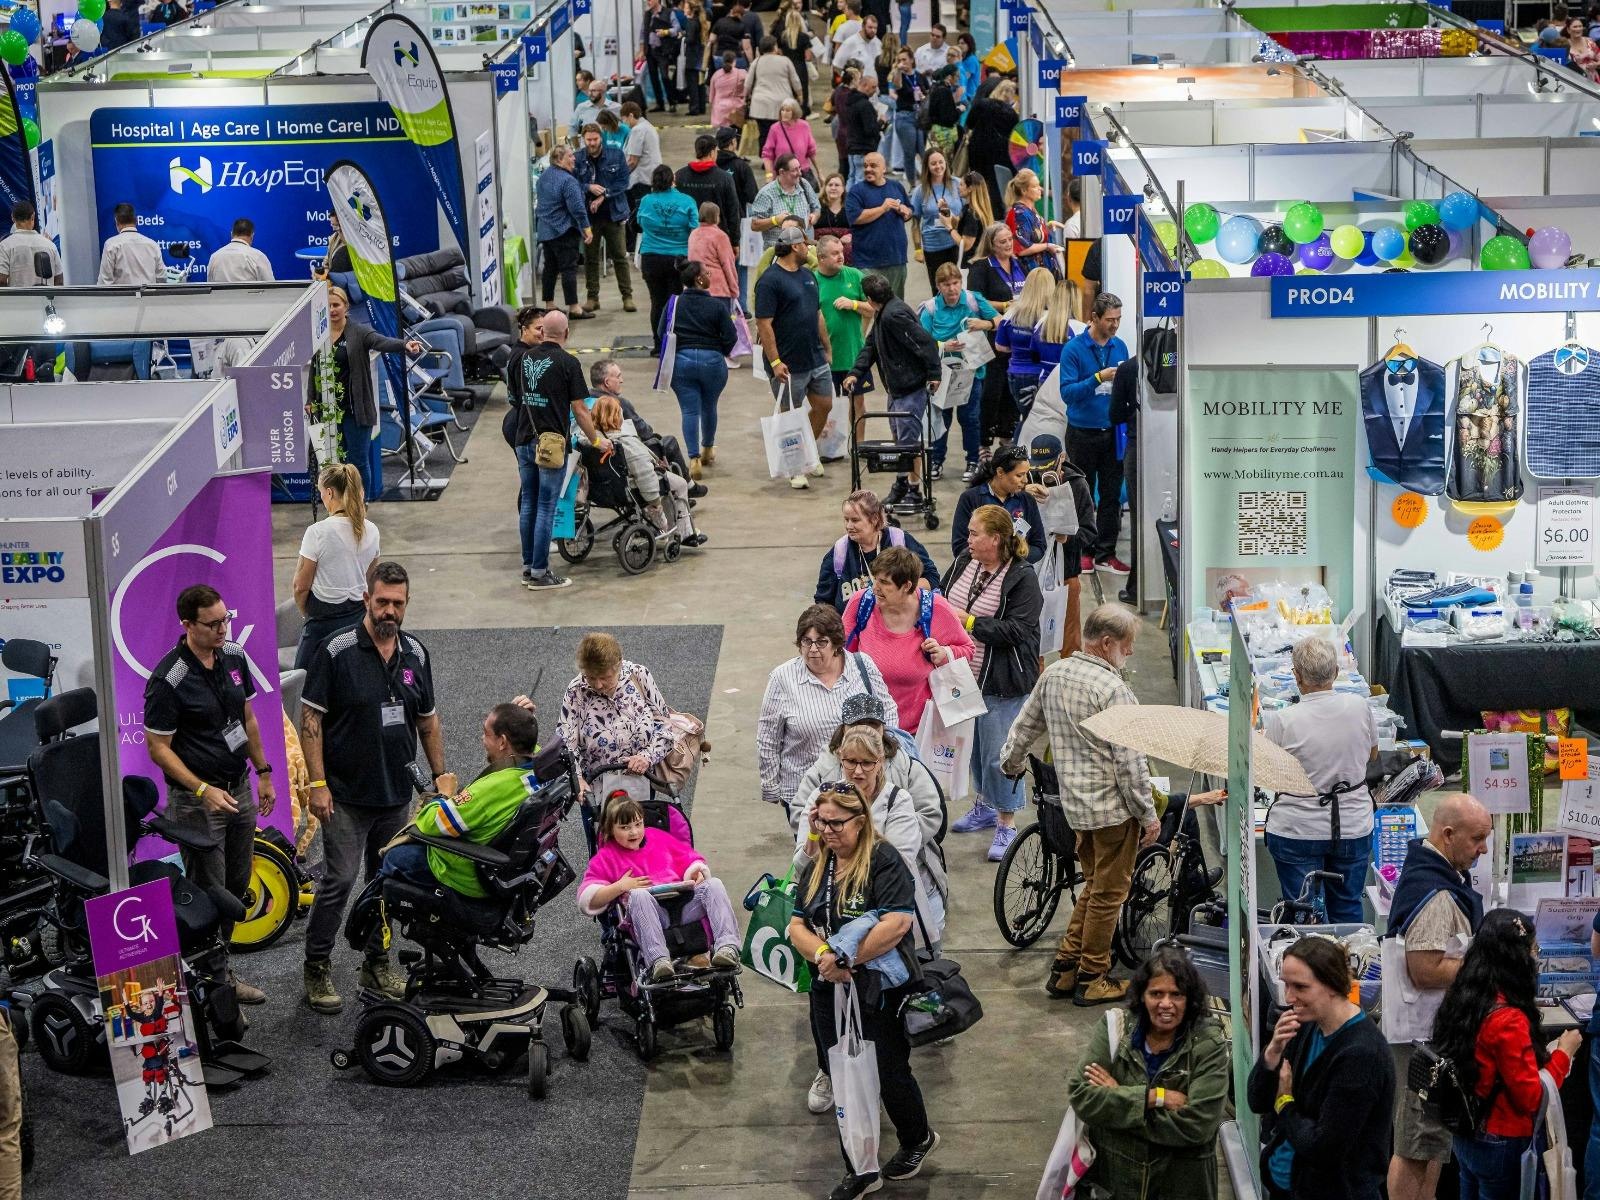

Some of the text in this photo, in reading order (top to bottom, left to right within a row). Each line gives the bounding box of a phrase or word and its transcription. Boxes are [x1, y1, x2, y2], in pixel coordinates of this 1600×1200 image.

[1012, 16, 1028, 24] 102
[530, 45, 540, 54] 91
[496, 69, 517, 77] PROD
[1042, 70, 1060, 80] 104
[16, 83, 35, 92] PROD
[504, 79, 510, 87] 3
[1059, 107, 1080, 118] 105
[111, 121, 174, 140] Hospital
[191, 122, 220, 139] Age
[224, 121, 260, 136] Care
[277, 120, 324, 135] Home
[1077, 152, 1100, 165] 106
[137, 214, 165, 226] Beds
[1108, 208, 1133, 223] 107
[1146, 282, 1180, 294] PROD
[1288, 282, 1590, 304] PROD4 MOBILITY
[1158, 297, 1168, 309] 4
[271, 372, 295, 390] S5
[1202, 401, 1343, 416] MOBILITY ME
[283, 410, 296, 463] SPONSOR
[270, 428, 282, 463] SILVER
[1211, 446, 1232, 454] Handy
[1270, 446, 1299, 454] Everyday
[6, 469, 95, 480] levels of ability.
[1204, 469, 1344, 482] www.Mobilityme.com.au
[26, 488, 41, 497] for
[45, 487, 60, 496] all
[62, 487, 83, 496] our
[1543, 527, 1589, 545] $6.00
[0, 541, 30, 549] HUNTER
[112, 532, 120, 558] S5
[2, 566, 65, 584] EXPO
[1484, 778, 1518, 791] $4.95
